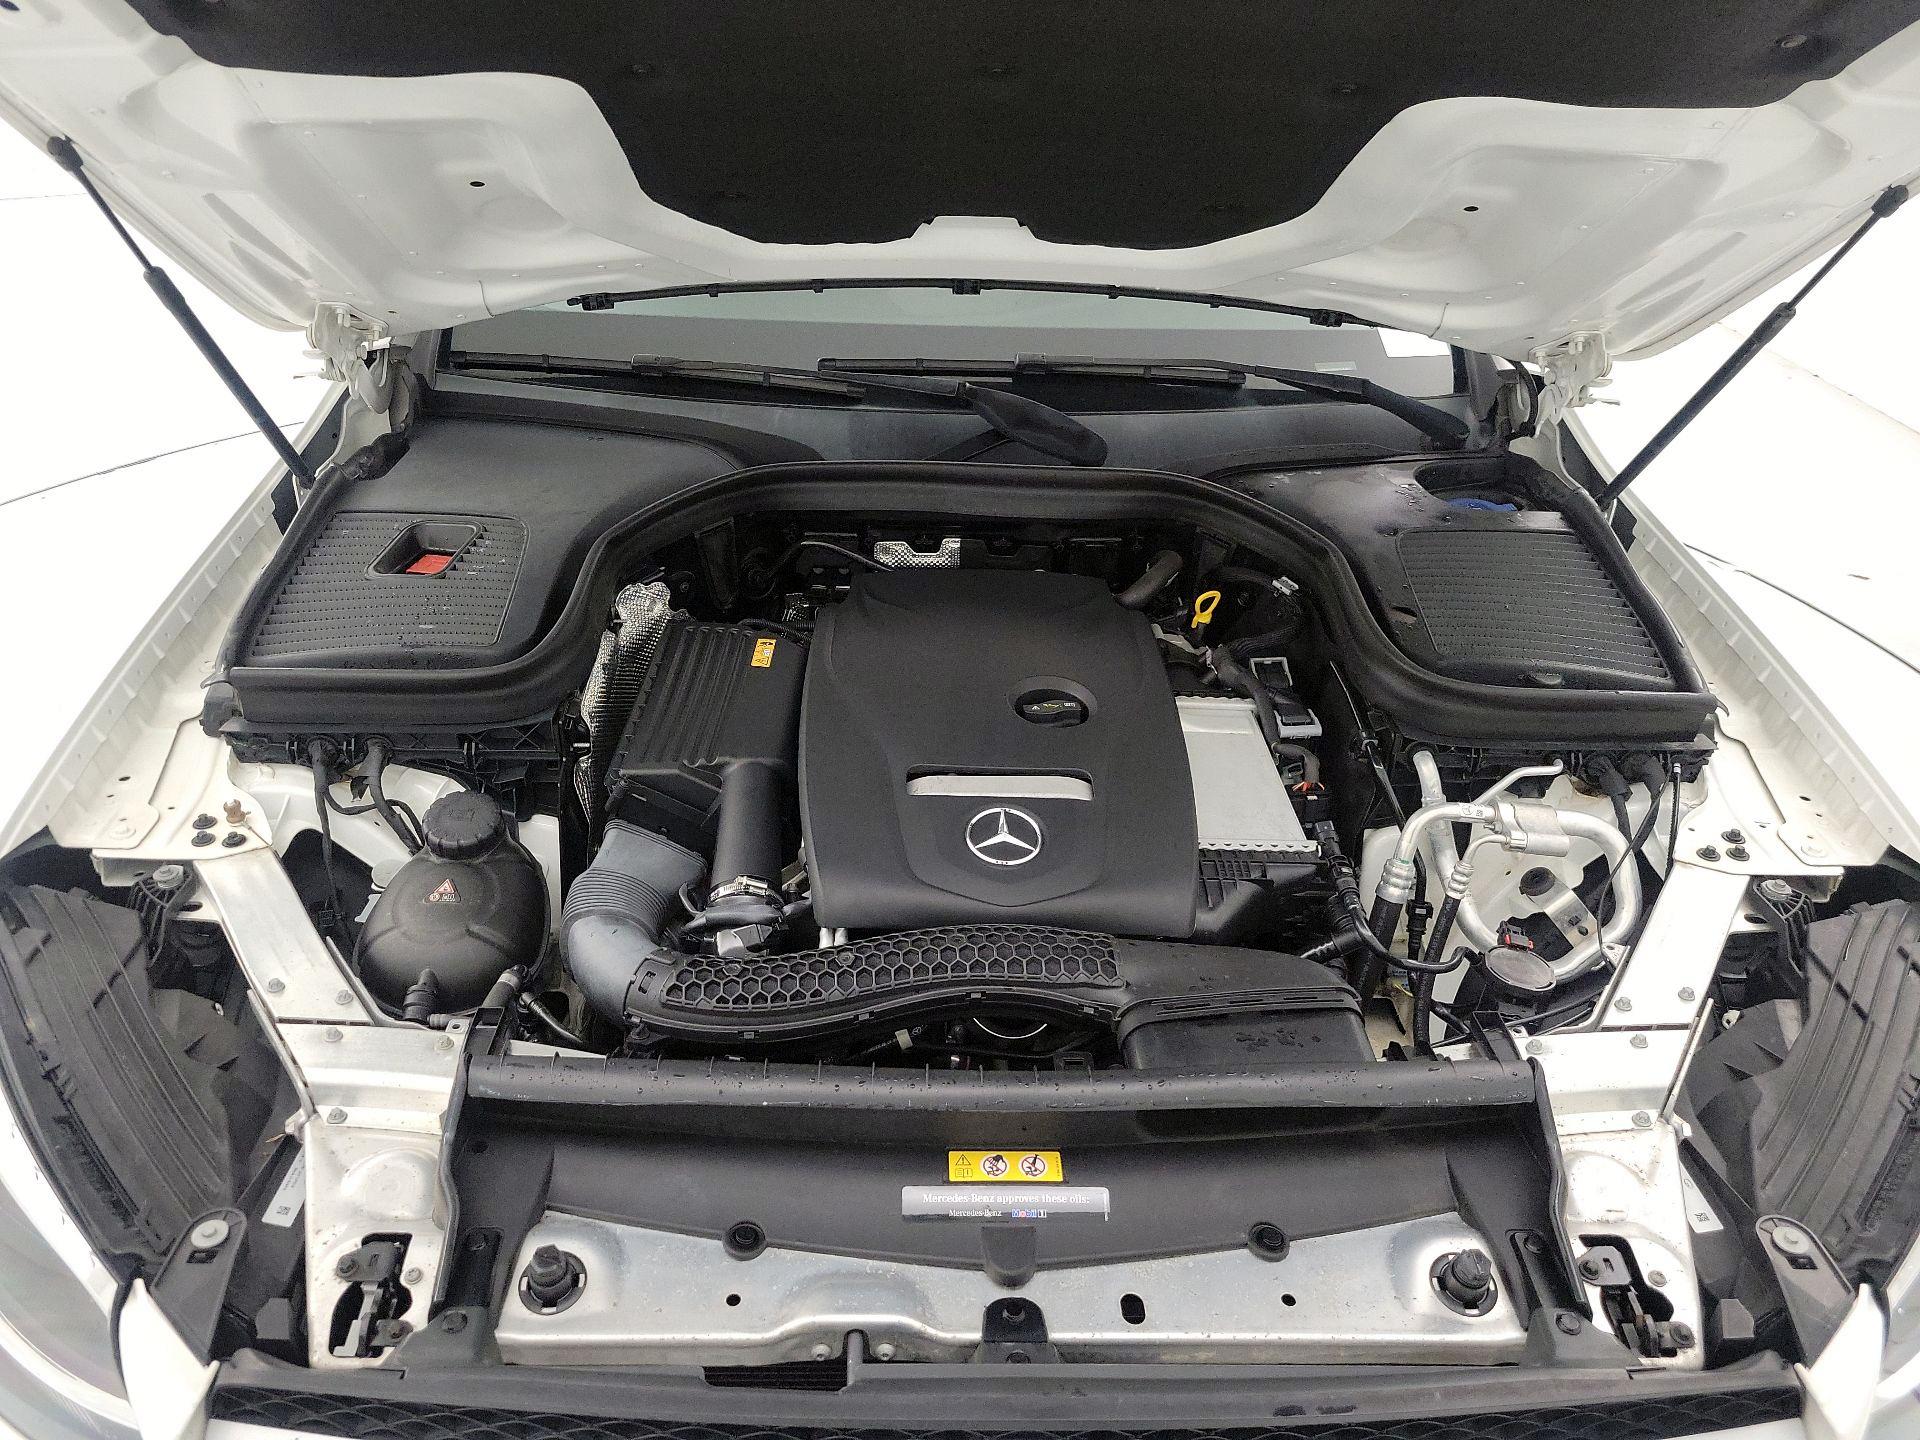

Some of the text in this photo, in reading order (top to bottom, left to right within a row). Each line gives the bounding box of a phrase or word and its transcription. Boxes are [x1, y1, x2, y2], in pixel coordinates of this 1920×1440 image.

[922, 1193, 995, 1203] Mercedes-Benz
[997, 1194, 1039, 1205] approves
[1042, 1194, 1067, 1204] these
[949, 1208, 1002, 1217] Mercedes-Benz
